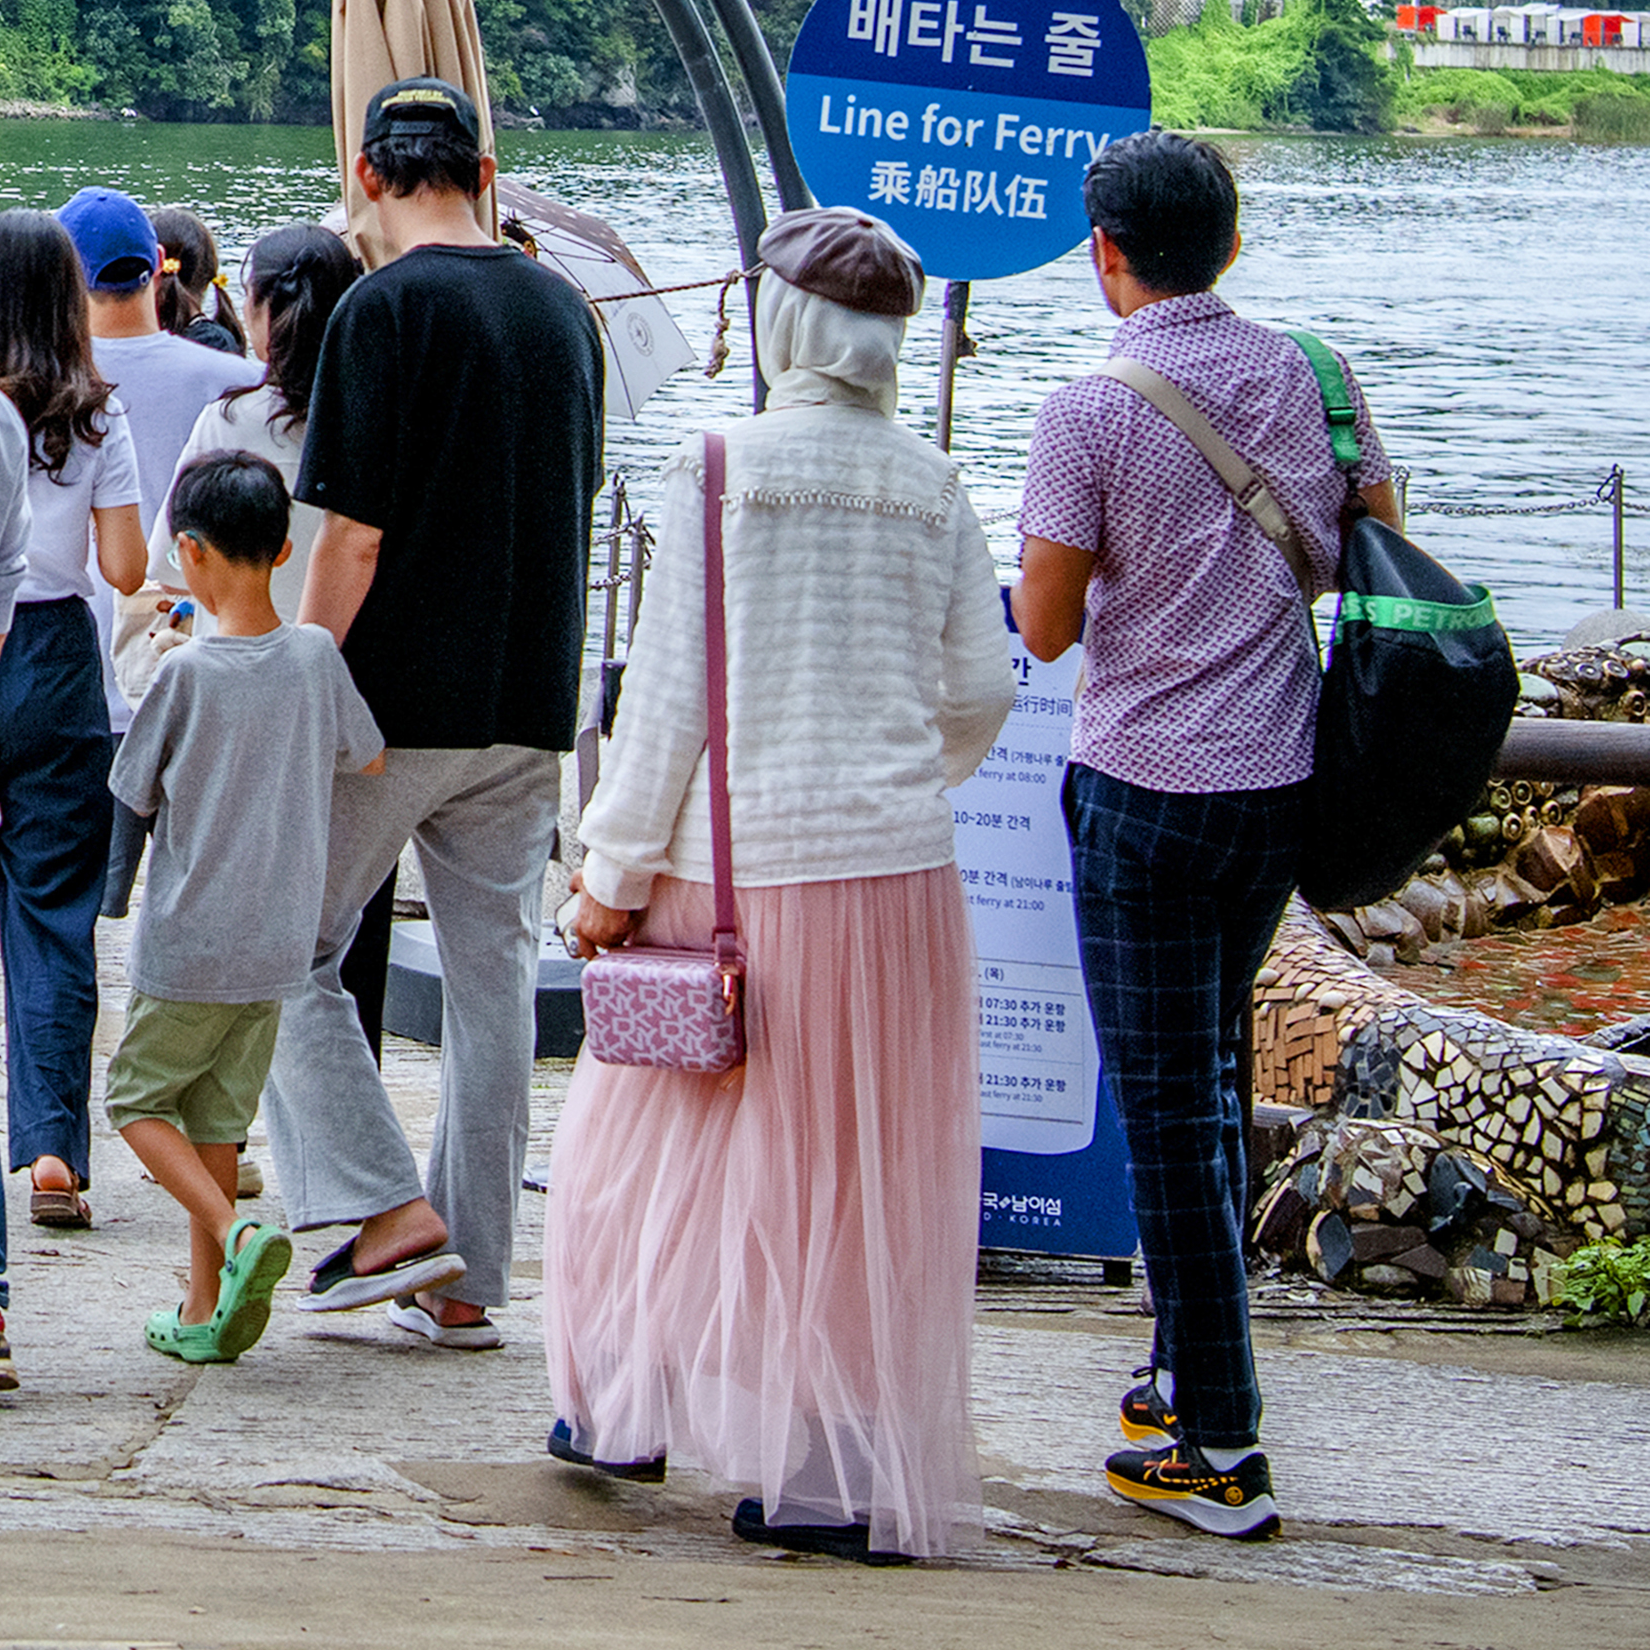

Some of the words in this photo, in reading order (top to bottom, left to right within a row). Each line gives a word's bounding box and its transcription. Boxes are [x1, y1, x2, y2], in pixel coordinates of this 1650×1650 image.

[1044, 11, 1102, 77] 줄
[819, 94, 909, 139] Line
[921, 103, 984, 148] for
[994, 113, 1110, 172] Ferry
[867, 161, 1048, 220] 乘船队伍
[1006, 814, 1031, 831] 간격
[984, 870, 1007, 887] 간격
[985, 997, 1017, 1010] 07:30
[986, 1014, 1017, 1028] 21:30
[986, 1073, 1018, 1088] 21:30
[1009, 1214, 1061, 1227] KOREA
